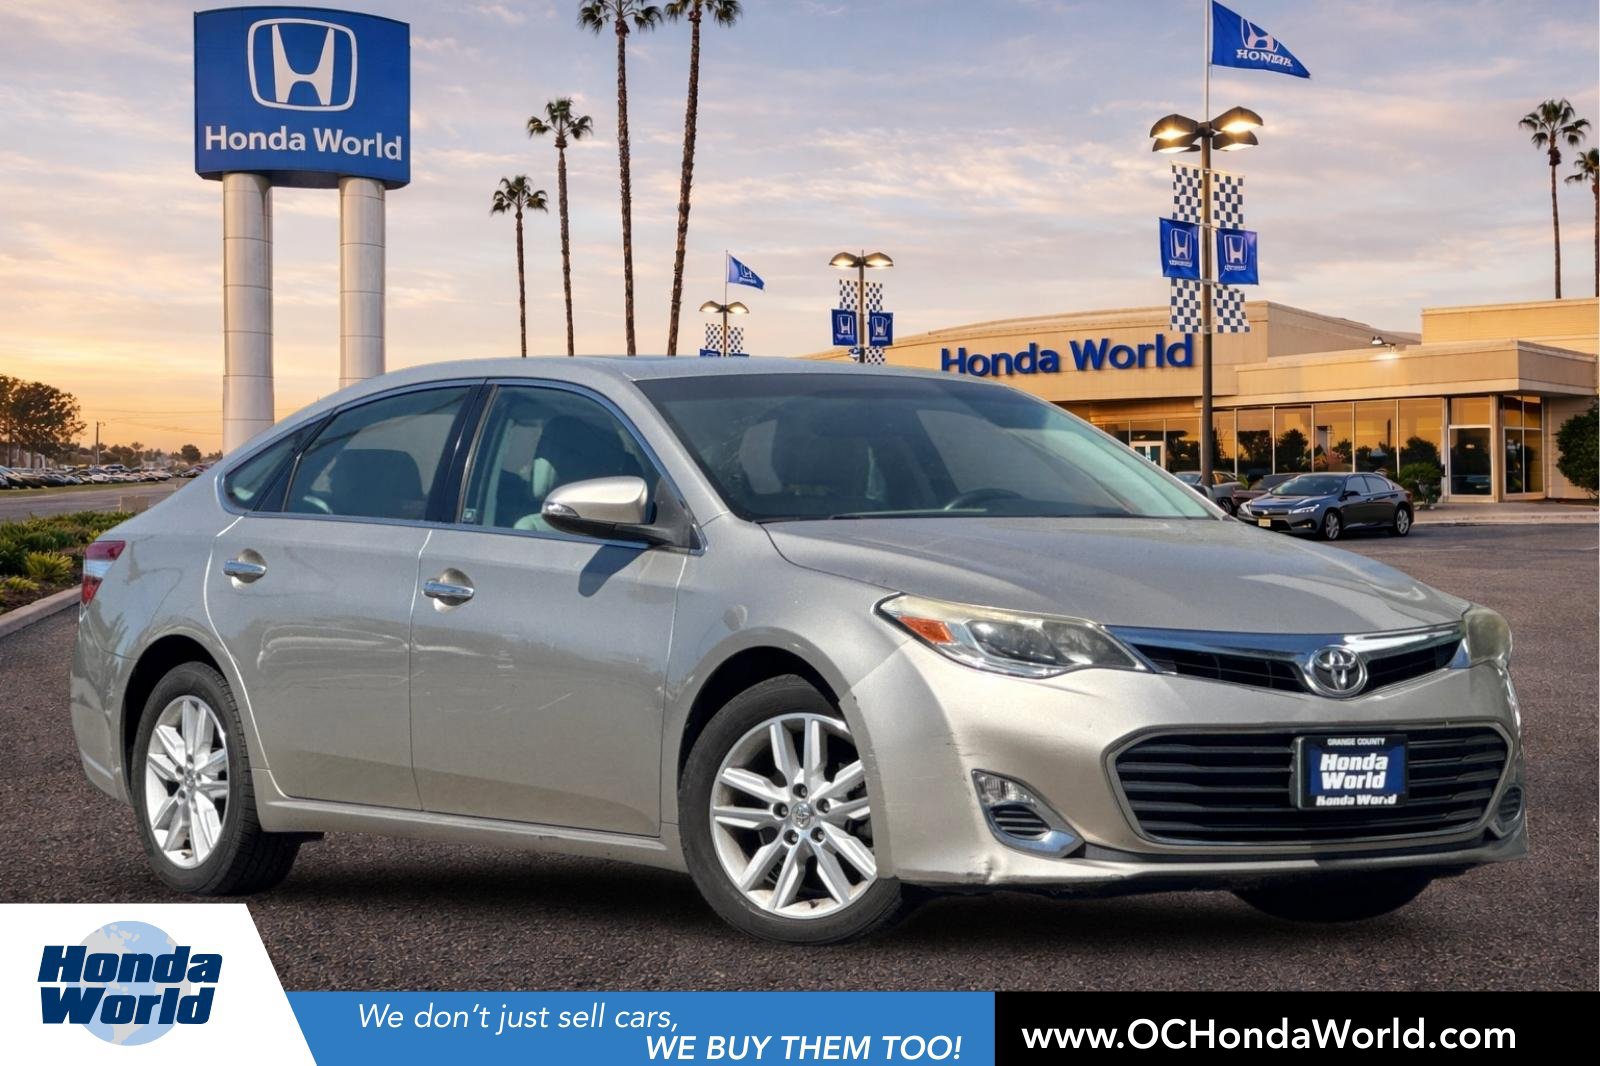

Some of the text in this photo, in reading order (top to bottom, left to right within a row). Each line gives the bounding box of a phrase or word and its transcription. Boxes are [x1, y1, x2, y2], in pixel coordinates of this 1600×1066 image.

[205, 125, 402, 161] Honda World
[941, 333, 1194, 377] Honda World
[1327, 737, 1386, 746] ORANGE COUNTY
[1319, 752, 1389, 771] Honda
[1321, 771, 1386, 790] World
[1315, 795, 1355, 806] Honda
